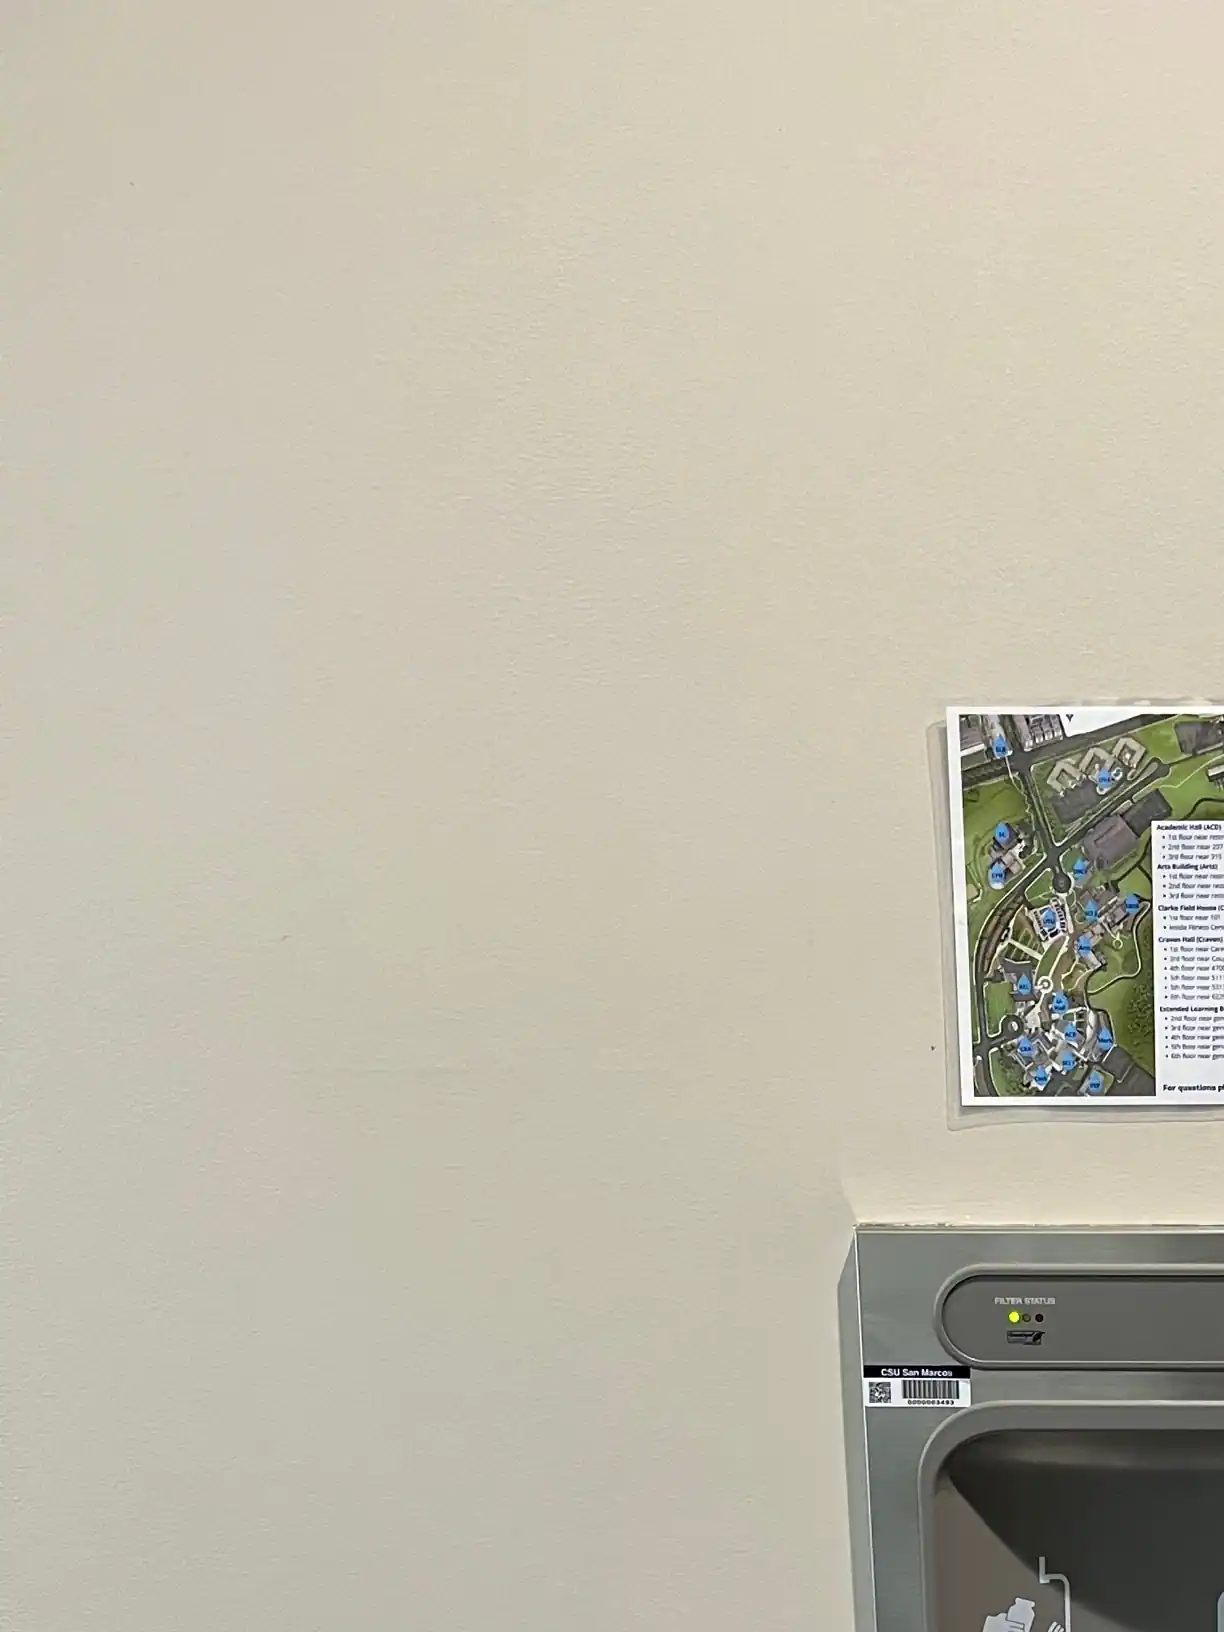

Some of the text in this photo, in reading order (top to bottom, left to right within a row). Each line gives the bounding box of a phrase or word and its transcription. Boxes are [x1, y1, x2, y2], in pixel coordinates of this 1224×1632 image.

[1178, 1084, 1216, 1093] questions
[994, 1297, 1056, 1305] FILTER STATUS
[881, 1368, 953, 1376] CSU San Marcos
